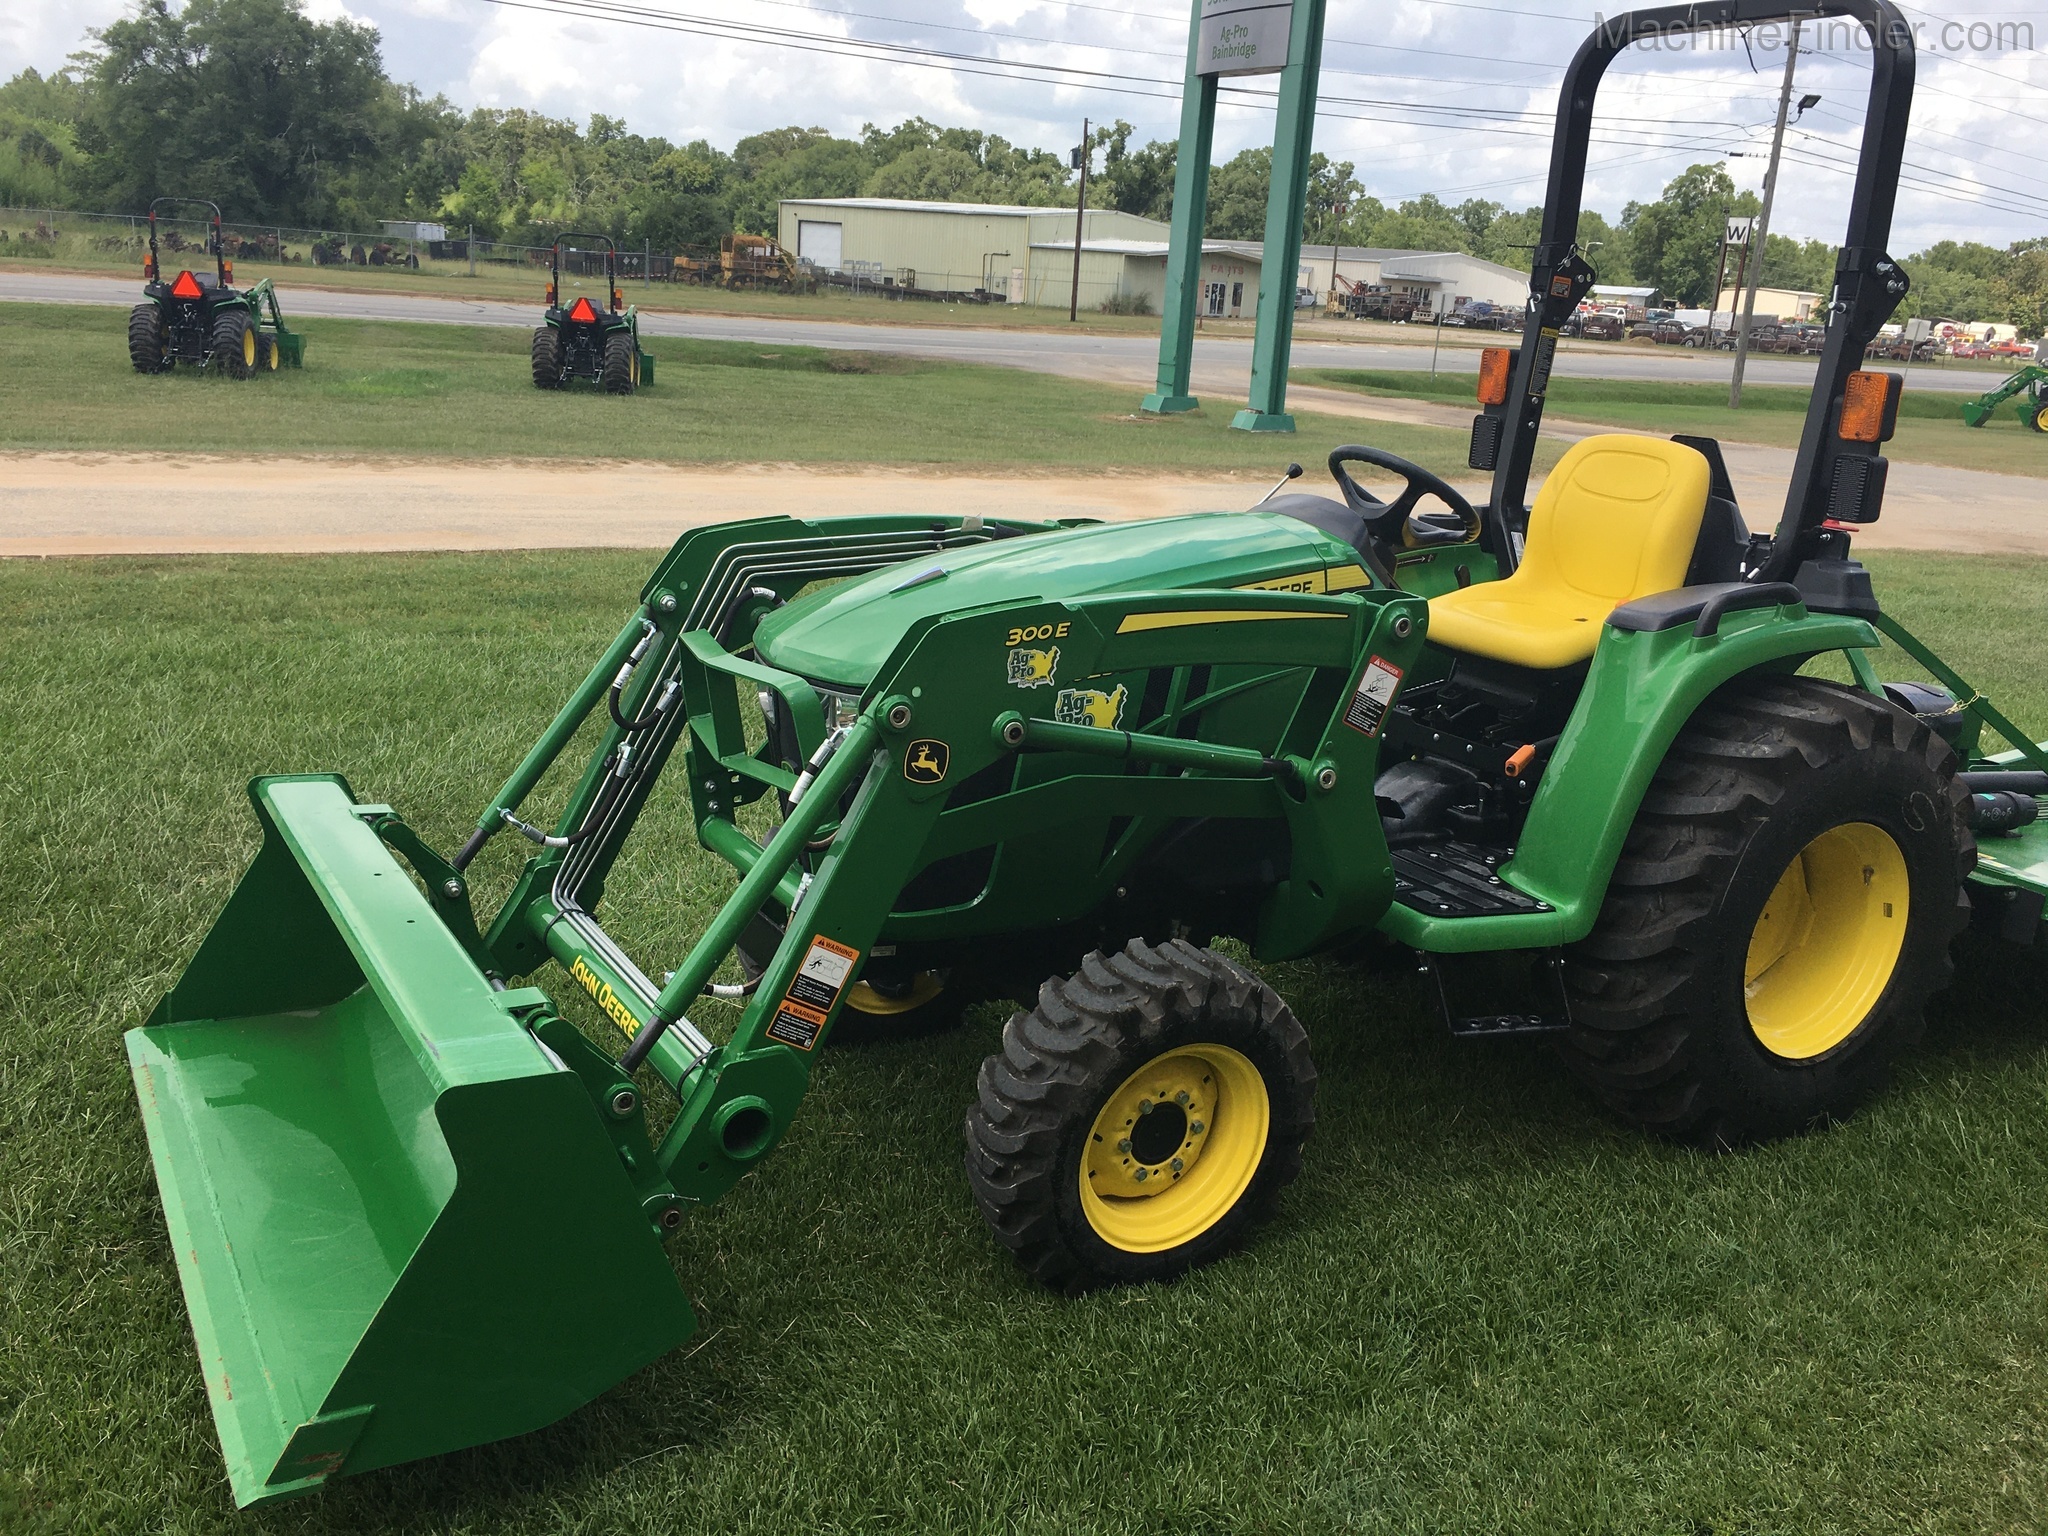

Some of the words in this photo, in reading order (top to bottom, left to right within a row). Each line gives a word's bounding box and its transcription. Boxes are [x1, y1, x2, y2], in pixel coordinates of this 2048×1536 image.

[1220, 24, 1249, 43] Ag-Pro
[1212, 42, 1257, 60] Bainbridge
[1010, 651, 1035, 666] Ag-
[1010, 665, 1035, 679] Pro
[1380, 661, 1399, 675] DANGER
[1059, 692, 1093, 713] Ag-
[825, 942, 853, 957] WARNING
[570, 954, 601, 999] JOHN
[598, 982, 640, 1042] DEERE
[792, 1007, 821, 1022] WARNING
